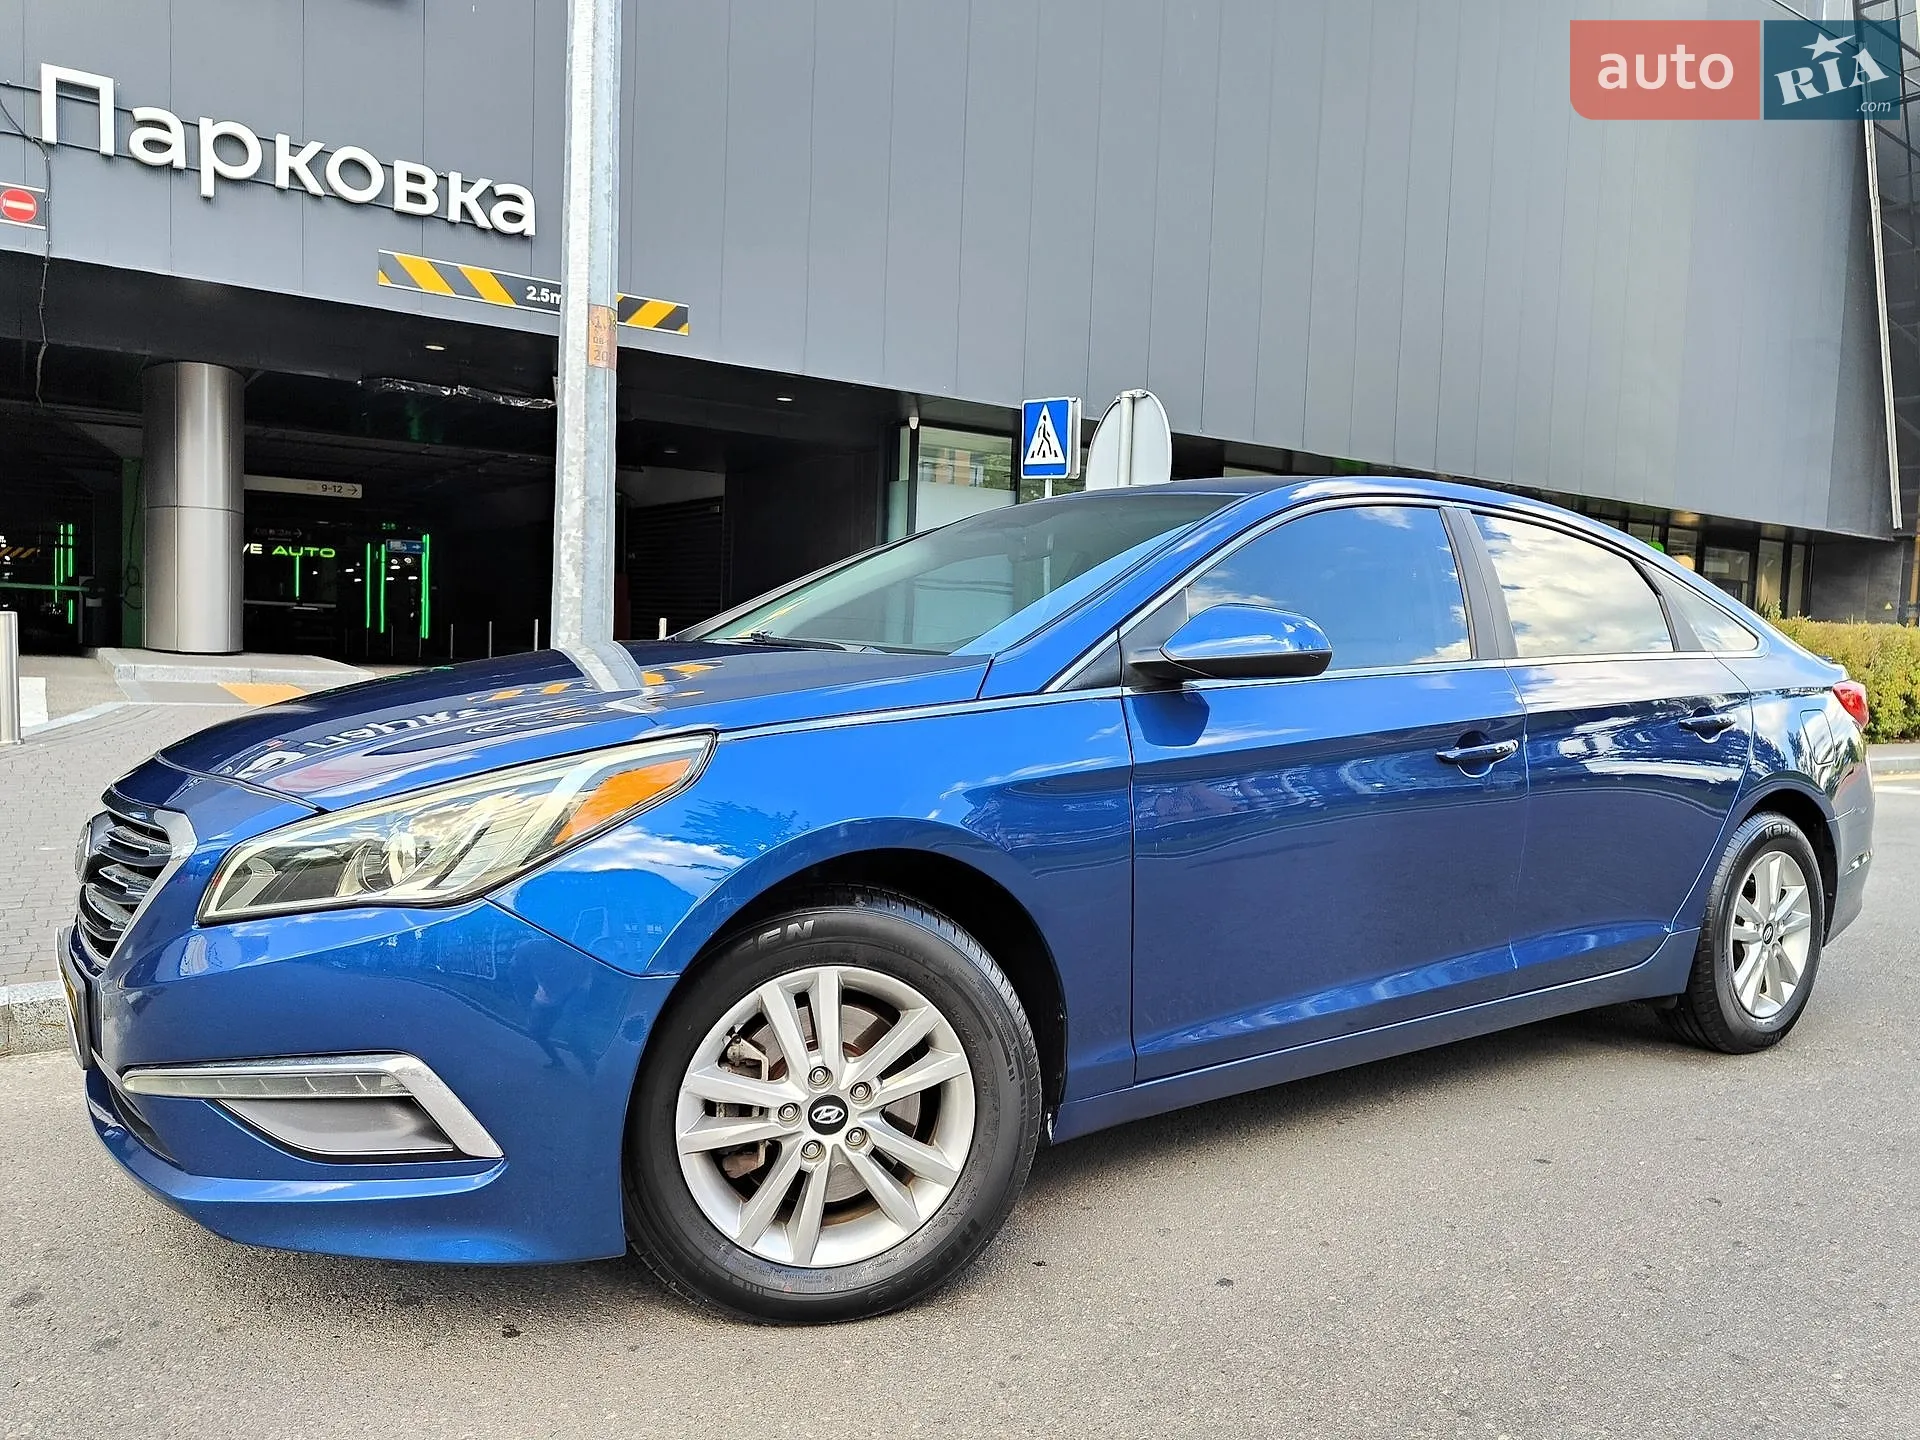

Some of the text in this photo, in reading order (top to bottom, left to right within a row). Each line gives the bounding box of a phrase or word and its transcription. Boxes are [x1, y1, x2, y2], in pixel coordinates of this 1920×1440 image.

[41, 63, 536, 237] Парковка
[321, 484, 343, 494] 9-12
[272, 546, 336, 558] AUTO
